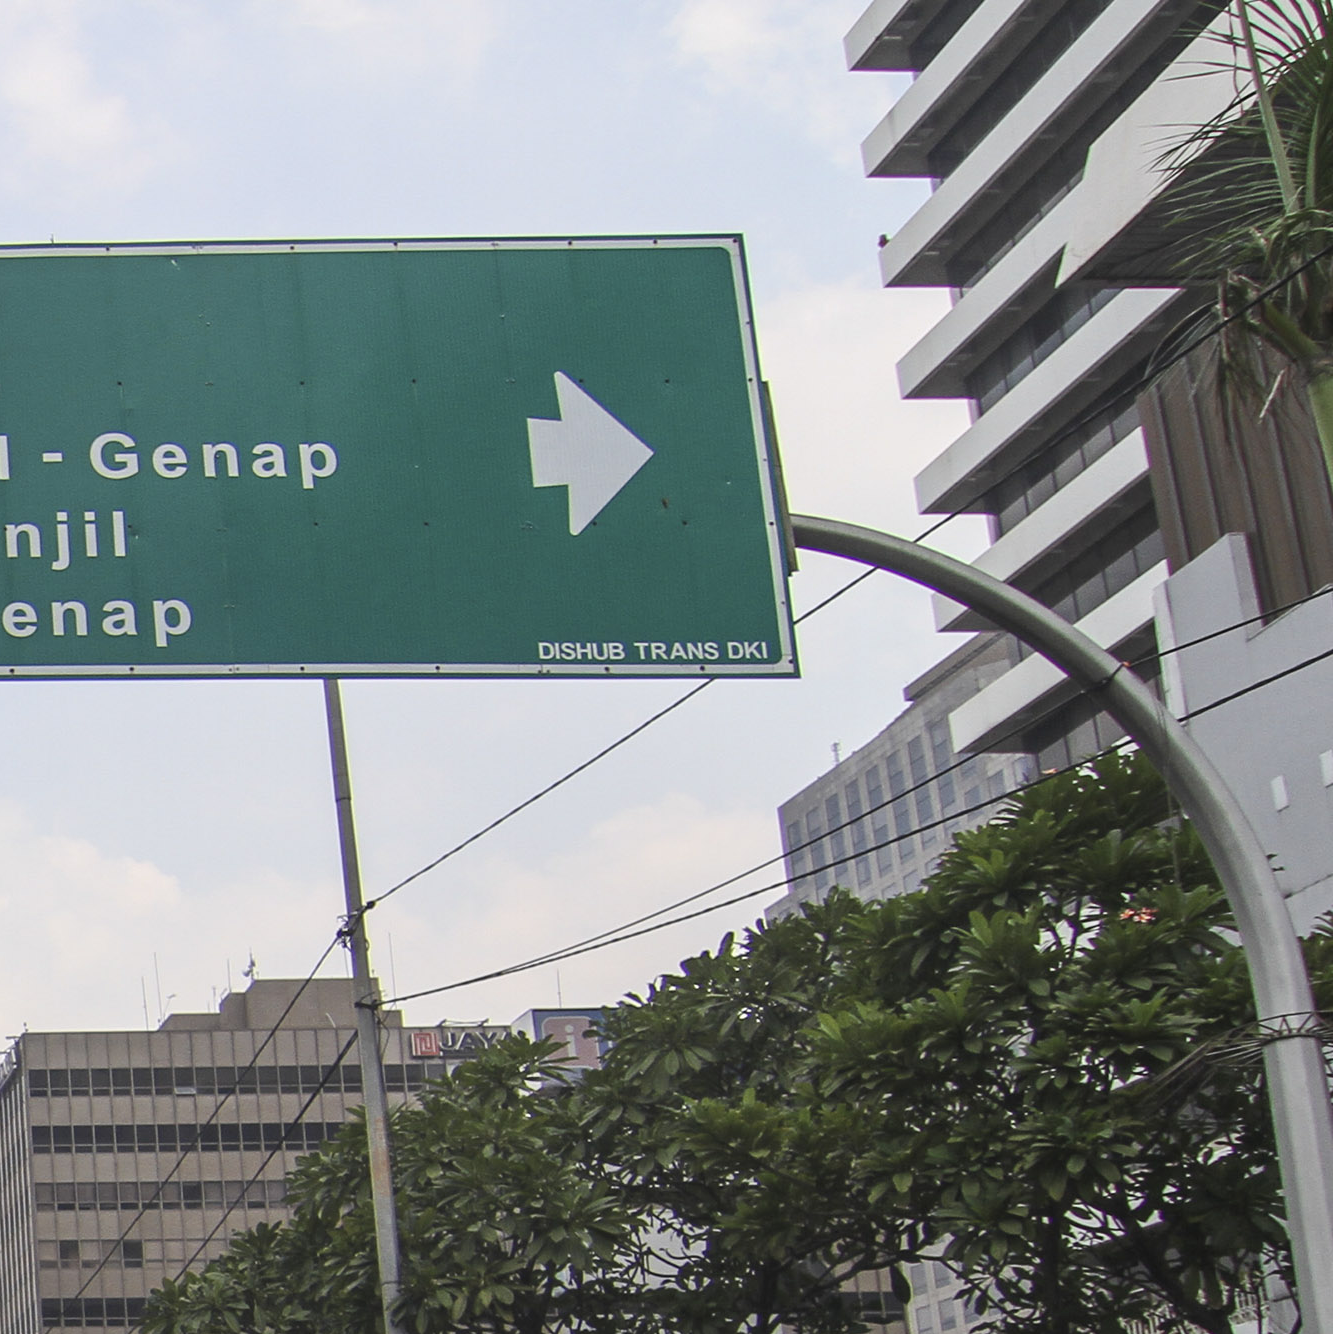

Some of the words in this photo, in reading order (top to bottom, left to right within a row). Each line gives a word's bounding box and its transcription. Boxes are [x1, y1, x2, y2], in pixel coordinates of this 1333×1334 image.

[538, 642, 625, 660] DISHUB
[634, 641, 720, 660] TRANS
[727, 641, 768, 660] DKI
